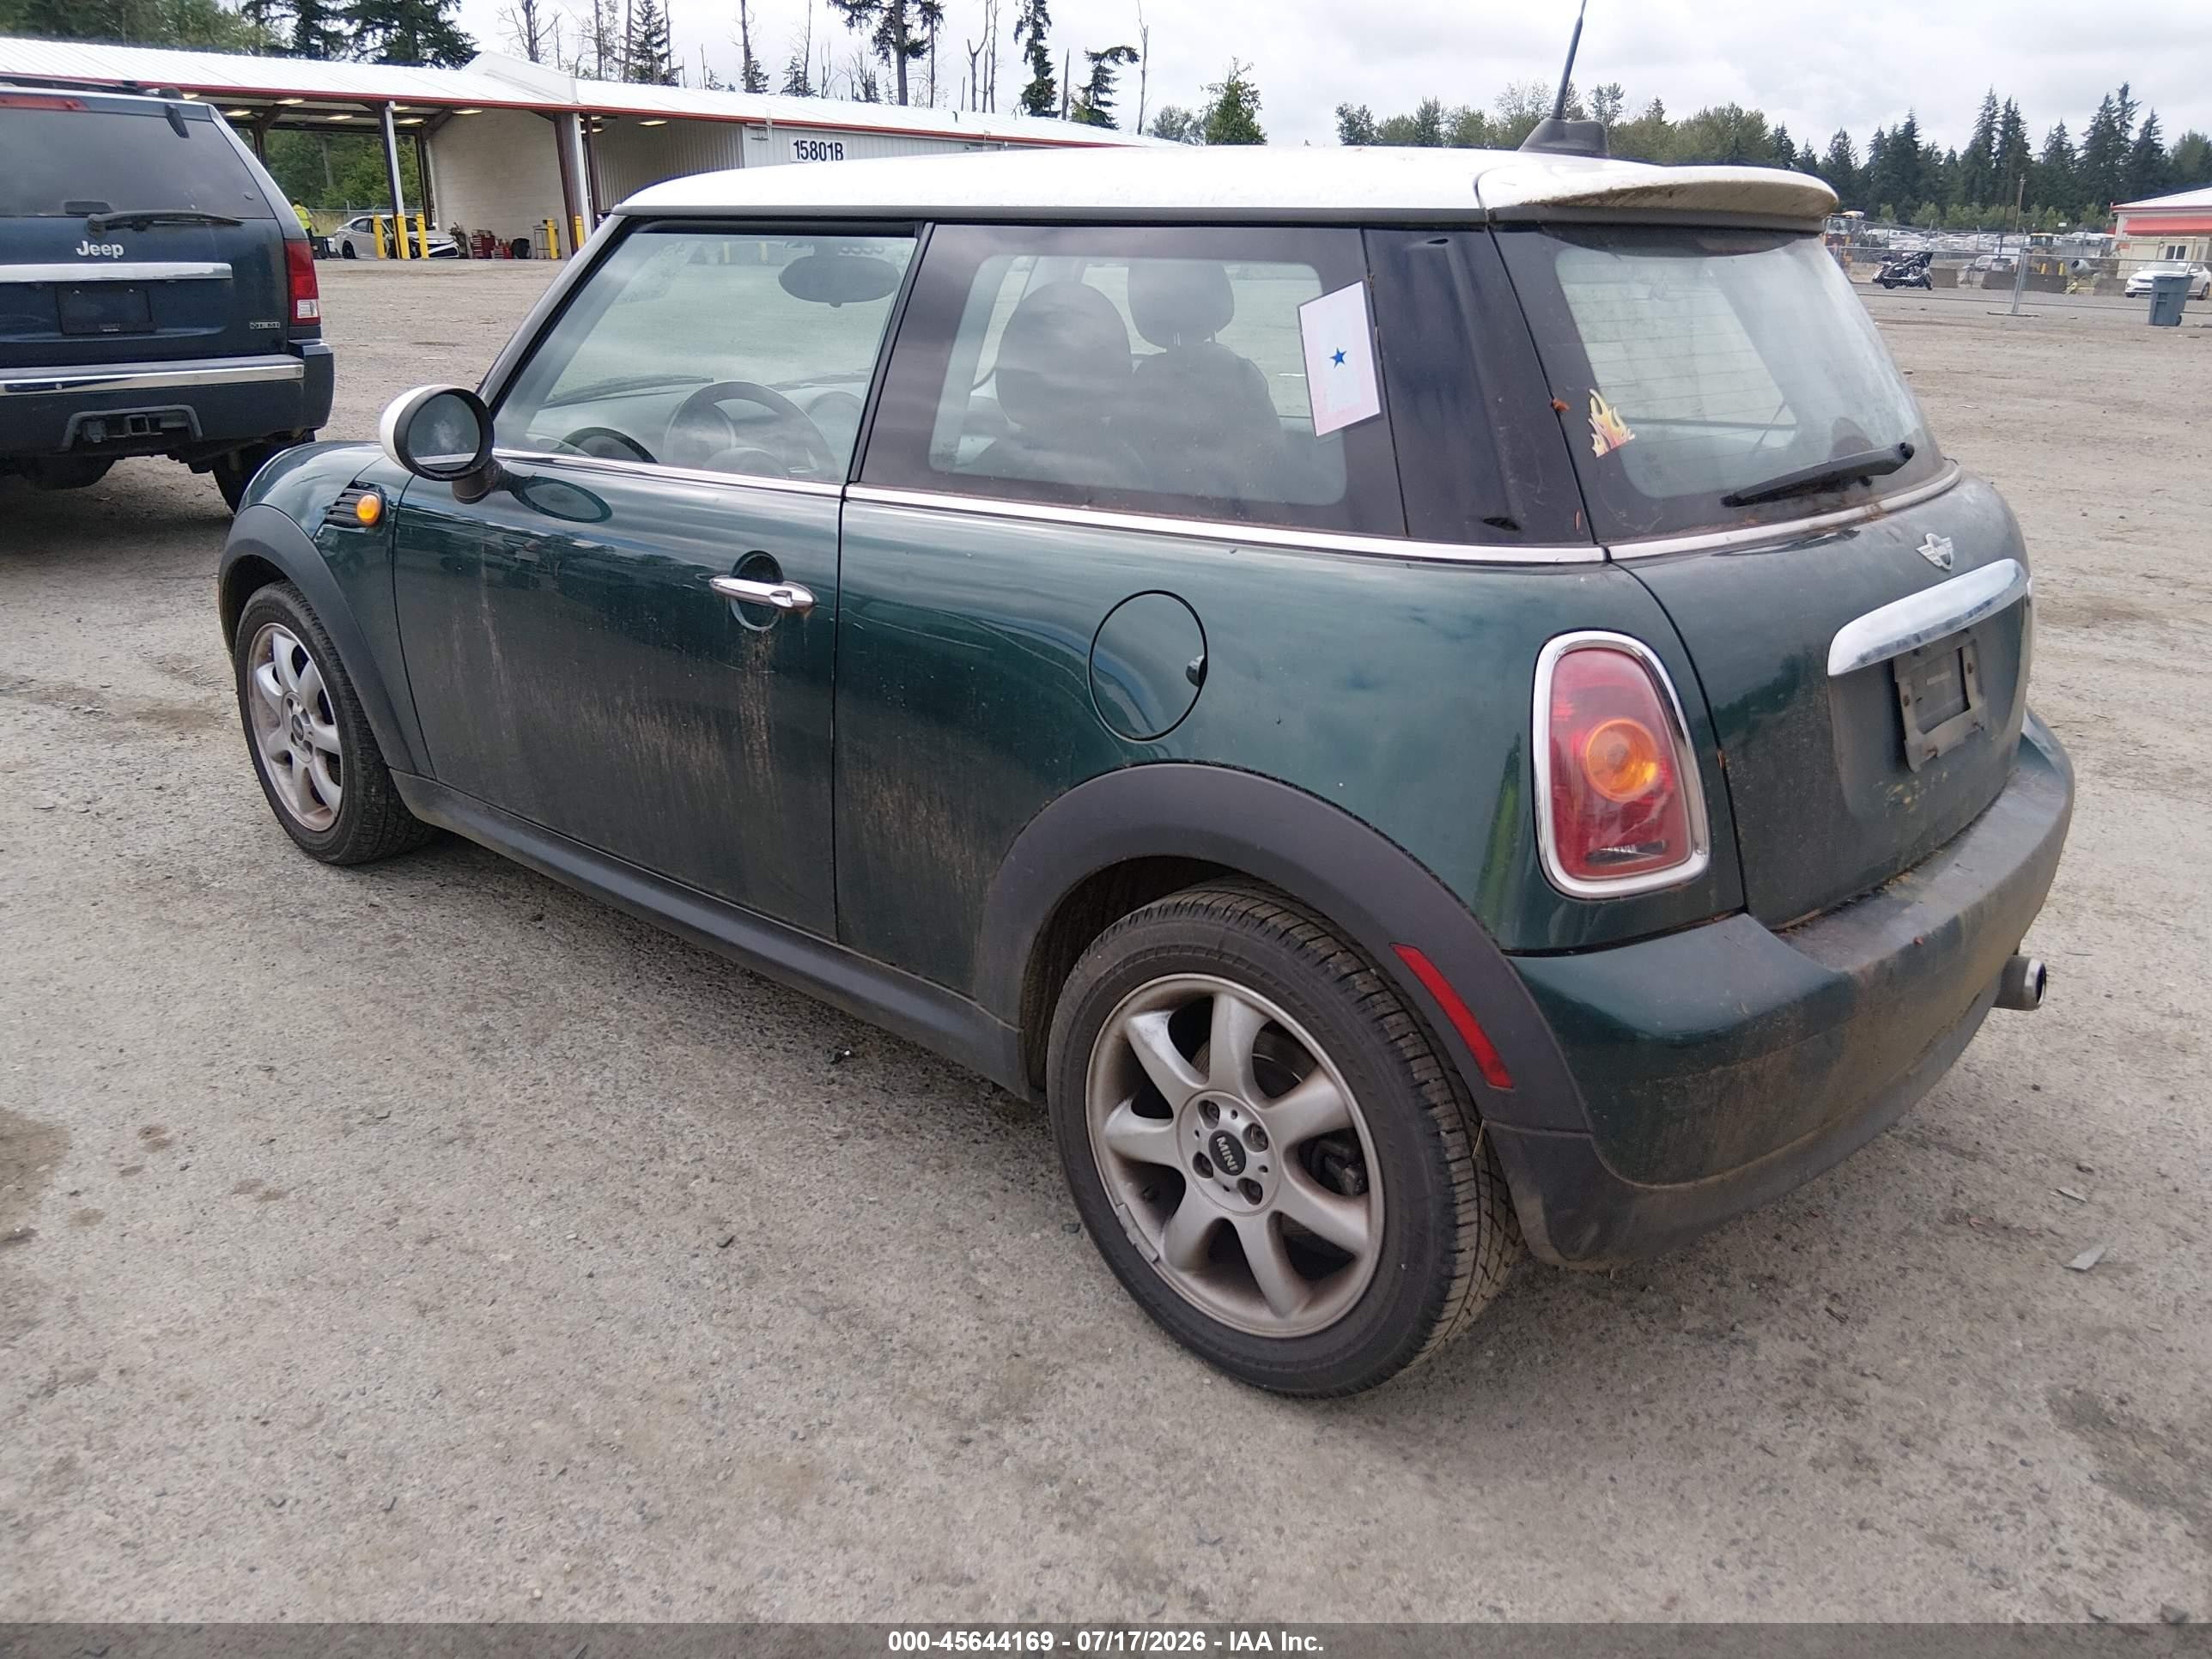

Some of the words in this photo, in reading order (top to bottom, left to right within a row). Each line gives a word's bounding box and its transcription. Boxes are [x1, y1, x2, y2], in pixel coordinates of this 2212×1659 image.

[793, 140, 844, 161] 15801B
[76, 240, 125, 258] Jeep
[1216, 1136, 1238, 1170] MINI
